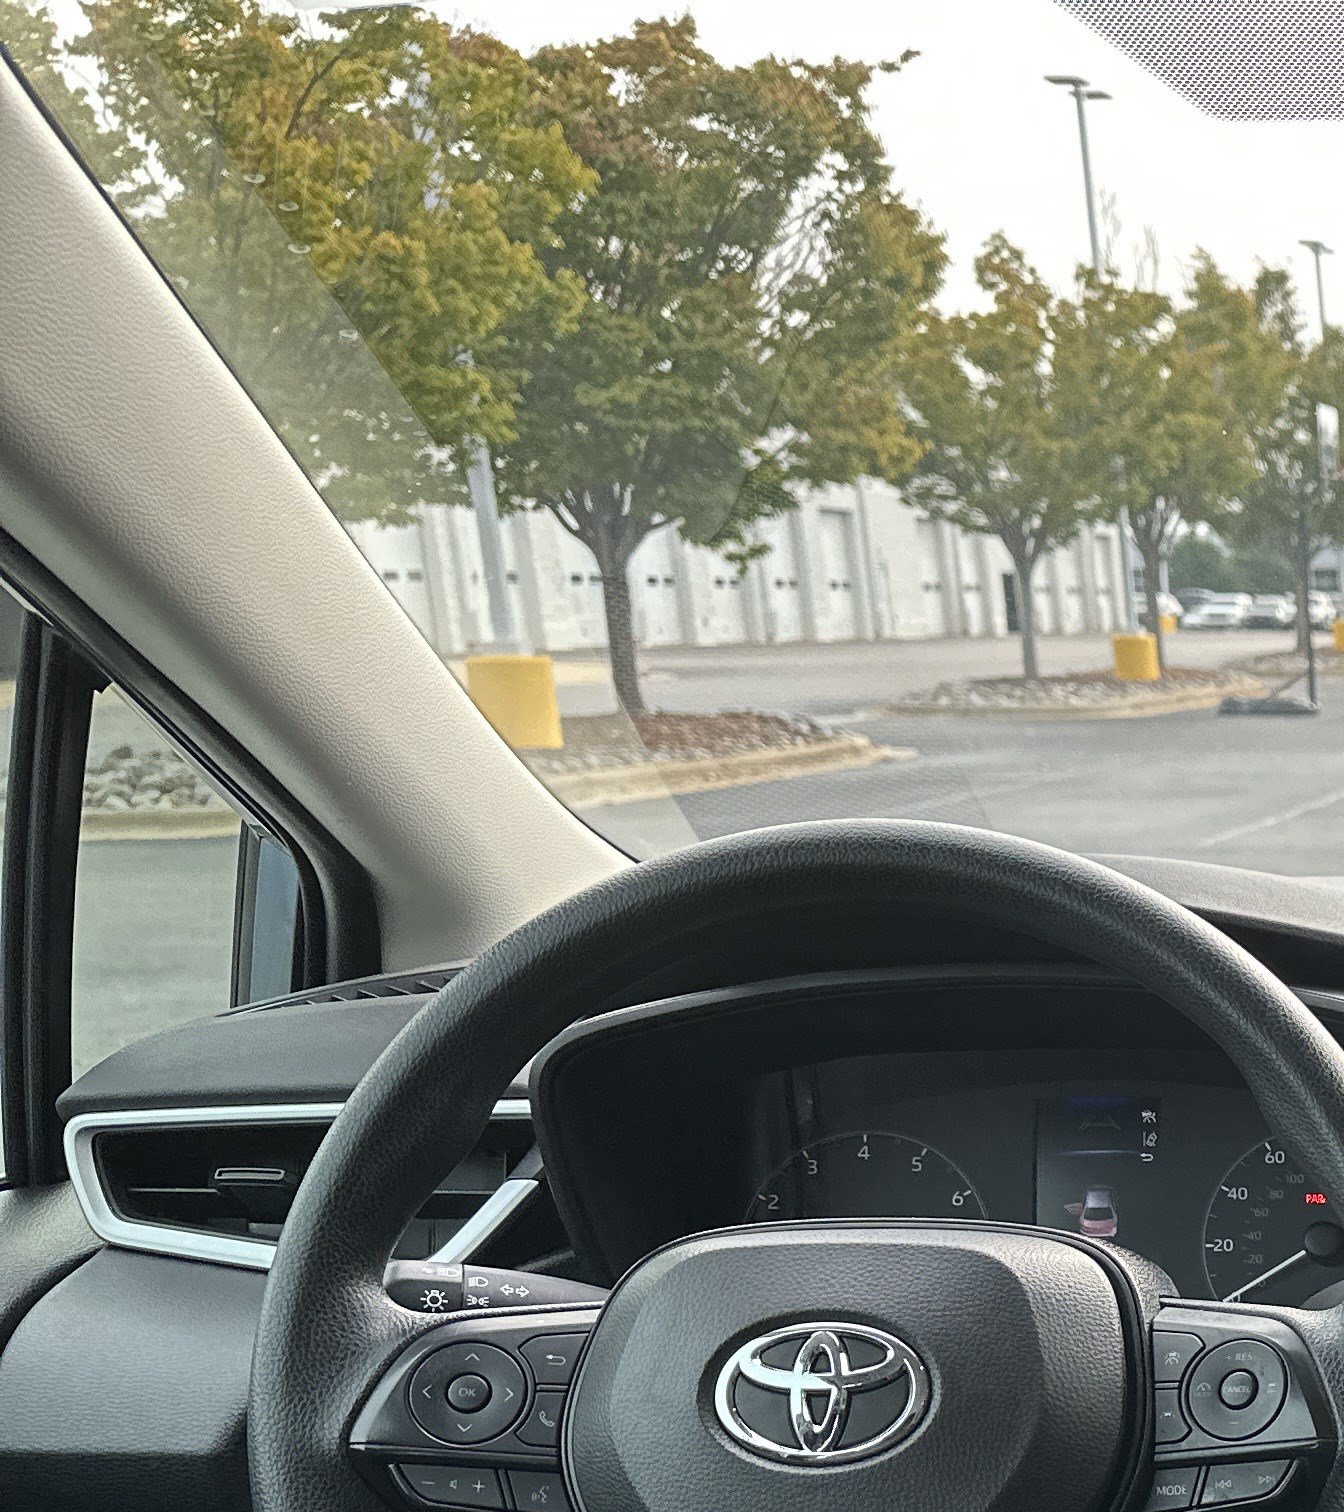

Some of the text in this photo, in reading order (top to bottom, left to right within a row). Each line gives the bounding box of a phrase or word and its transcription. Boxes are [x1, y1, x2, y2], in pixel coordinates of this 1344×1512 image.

[857, 1145, 871, 1160] 4
[1264, 1150, 1285, 1164] 60
[807, 1159, 818, 1175] 3
[911, 1156, 922, 1172] 5
[951, 1191, 964, 1206] 6
[1227, 1187, 1248, 1200] 40
[767, 1194, 779, 1210] 2
[1213, 1238, 1234, 1252] 20
[458, 1387, 476, 1398] OK
[1156, 1484, 1187, 1495] MODE
